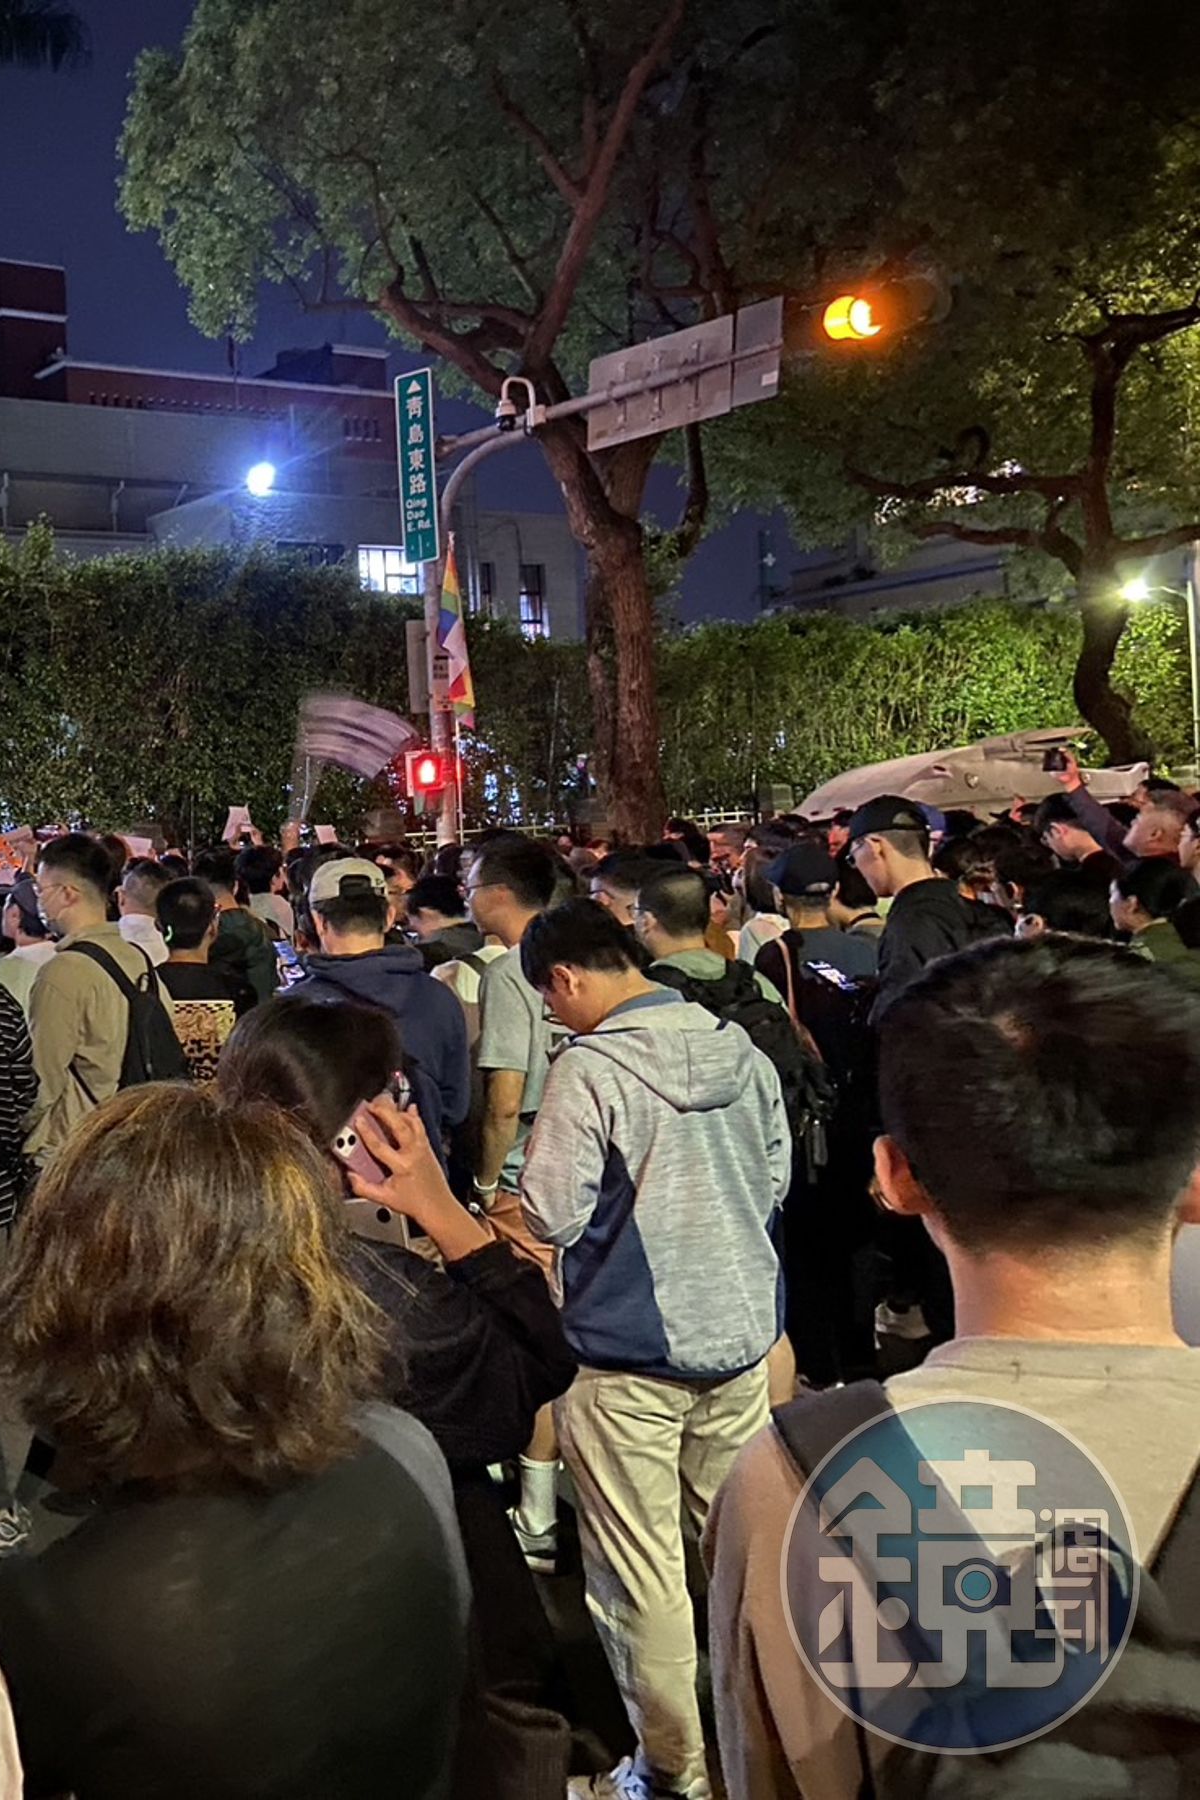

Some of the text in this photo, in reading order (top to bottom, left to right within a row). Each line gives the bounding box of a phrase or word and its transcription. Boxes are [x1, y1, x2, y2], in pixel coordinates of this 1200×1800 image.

[406, 396, 426, 495] 青島東路
[406, 498, 427, 509] Qing
[407, 510, 425, 520] Dao
[407, 519, 432, 532] E. Rd.
